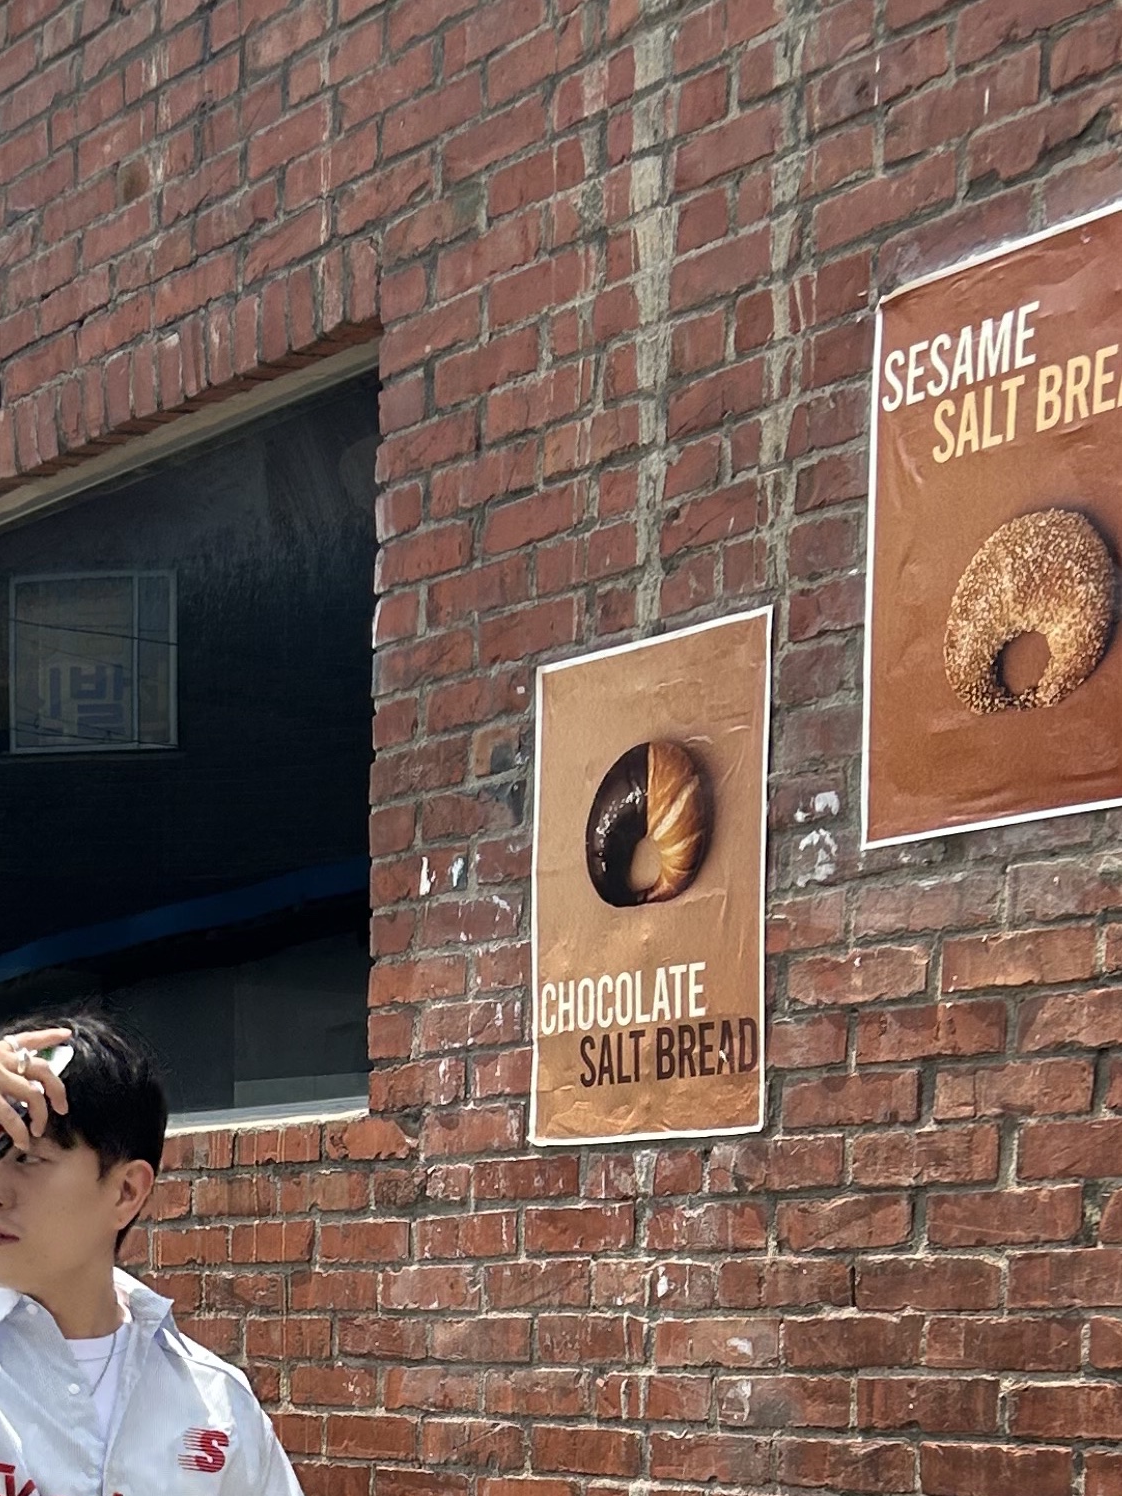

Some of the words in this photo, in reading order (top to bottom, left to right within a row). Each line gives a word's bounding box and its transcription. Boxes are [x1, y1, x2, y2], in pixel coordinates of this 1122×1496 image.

[882, 300, 1040, 412] SESAME
[933, 374, 1025, 464] SALT
[1036, 344, 1122, 433] BRE
[541, 961, 707, 1035] CHOCOLATE
[580, 1029, 646, 1088] SALT
[656, 1017, 758, 1081] BREAD
